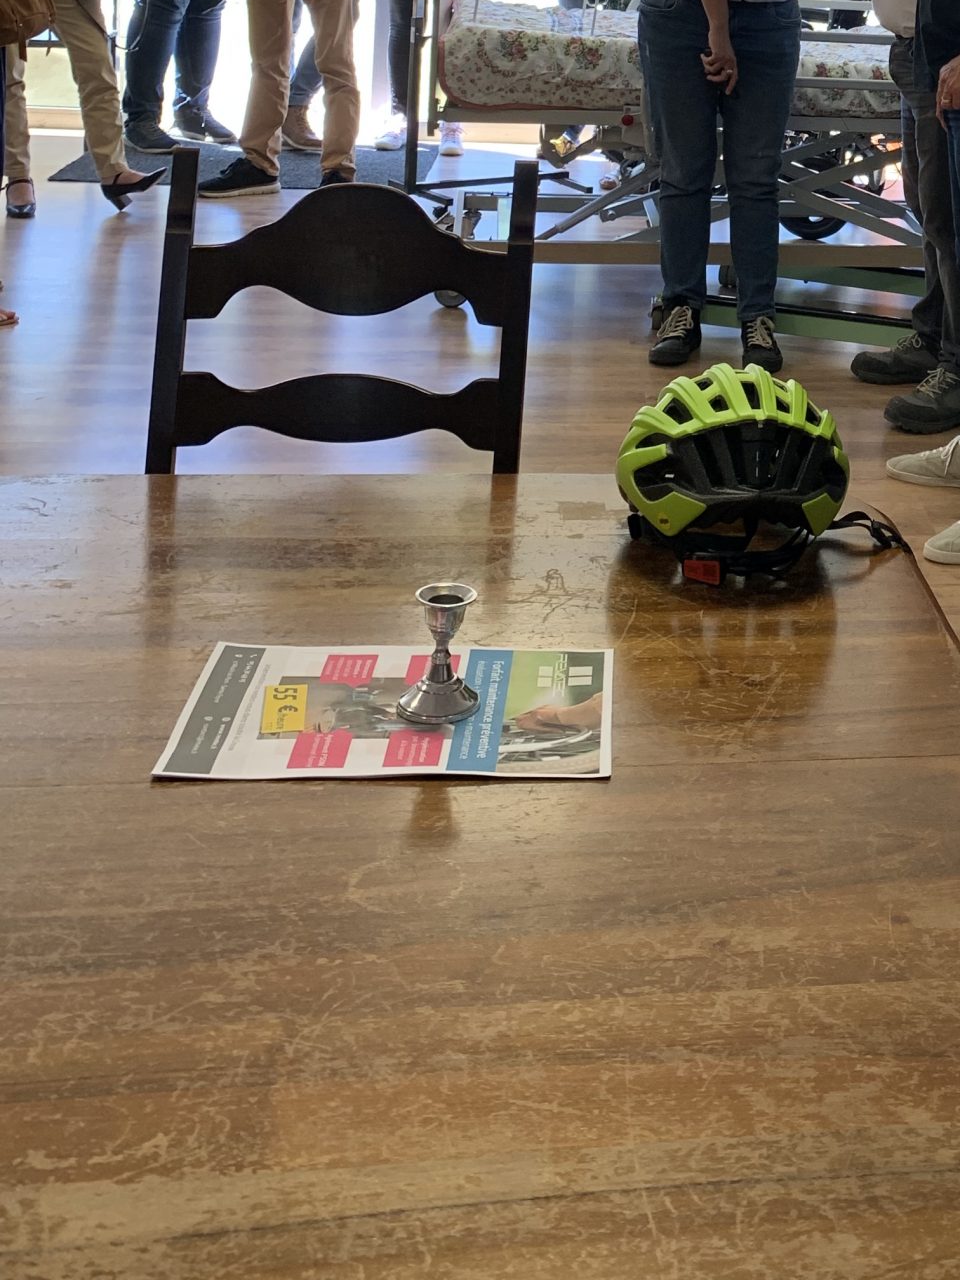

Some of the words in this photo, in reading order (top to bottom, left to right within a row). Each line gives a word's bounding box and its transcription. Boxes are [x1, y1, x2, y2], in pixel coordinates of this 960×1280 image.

[490, 660, 505, 682] Forfait
[273, 687, 298, 701] 55
[482, 682, 502, 723] maintenance
[278, 705, 299, 713] €
[459, 726, 474, 760] maintenance
[477, 723, 493, 759] préventive
